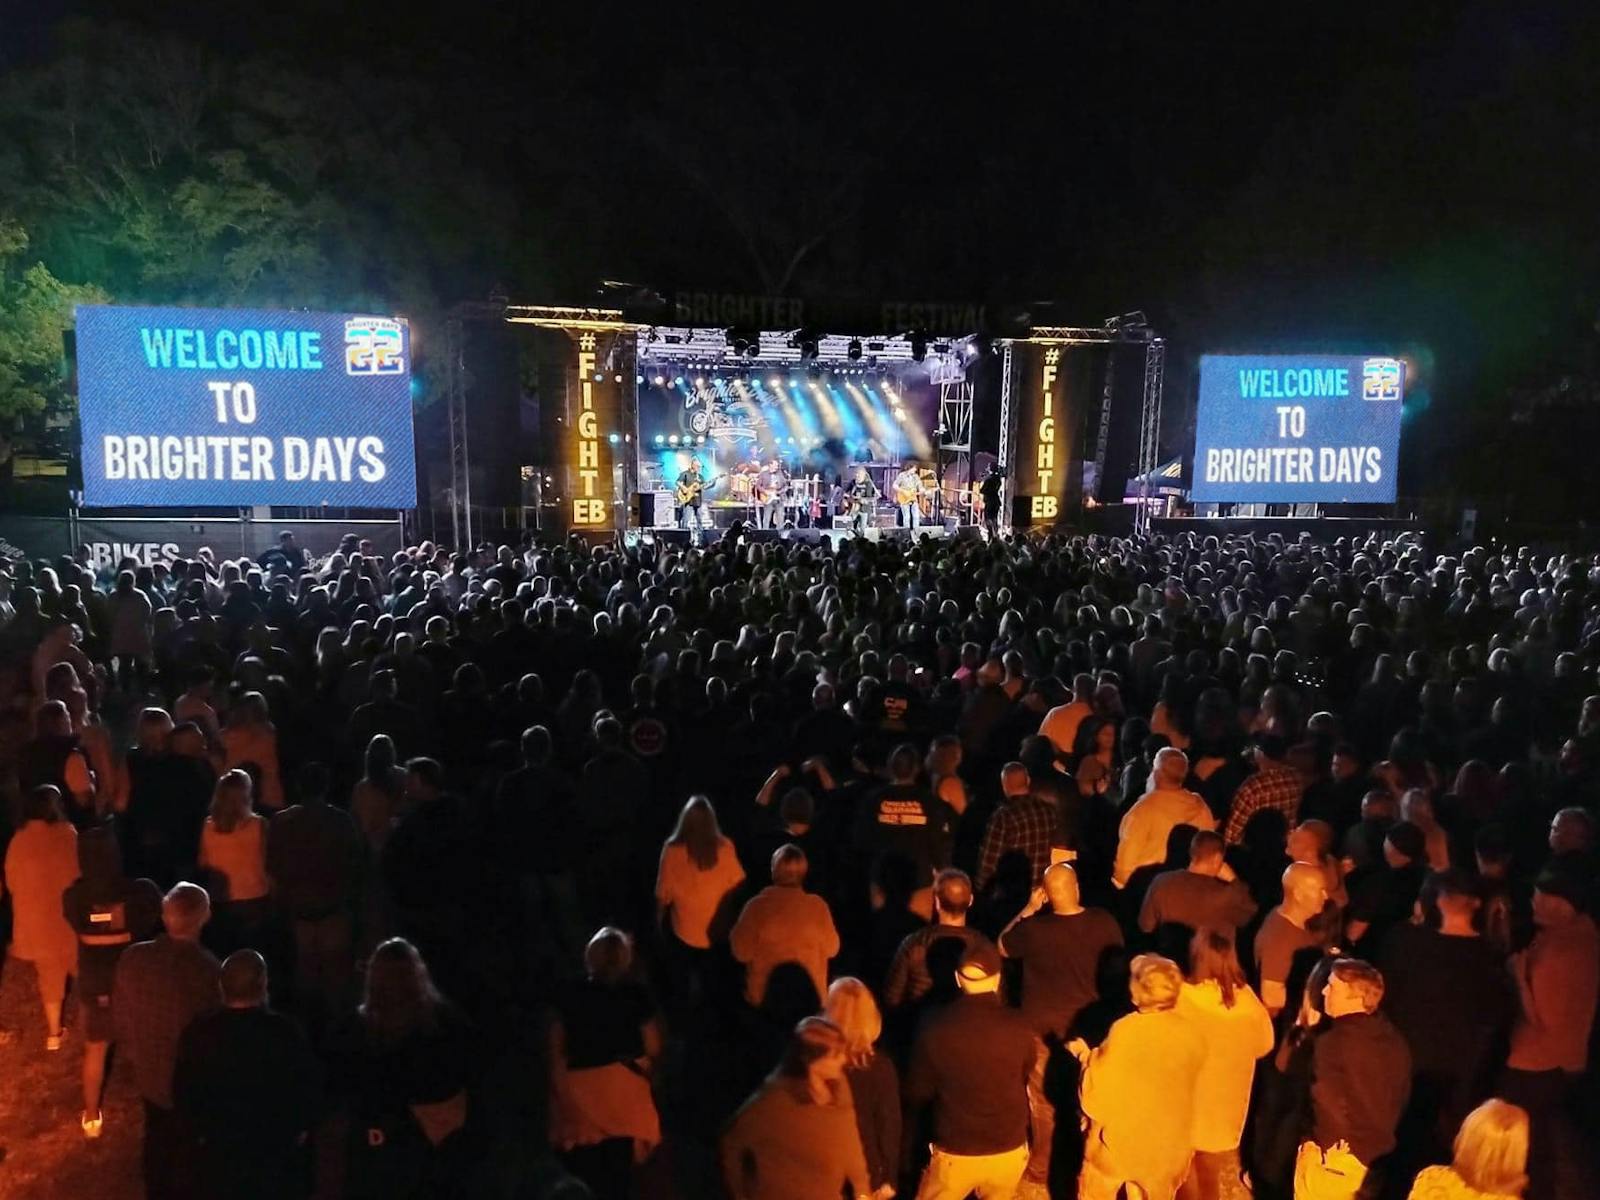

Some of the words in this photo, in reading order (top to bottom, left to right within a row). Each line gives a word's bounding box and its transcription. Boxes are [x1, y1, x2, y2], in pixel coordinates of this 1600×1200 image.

[674, 291, 804, 326] BRIGHTER
[139, 328, 323, 370] WELCOME
[345, 329, 404, 375] 22
[1239, 368, 1349, 398] WELCOME
[208, 381, 257, 423] TO
[1276, 406, 1306, 438] TO
[104, 435, 275, 481] BRIGHTER
[283, 436, 387, 483] DAYS
[1206, 447, 1314, 483] BRIGHTER
[1319, 446, 1382, 483] DAYS
[92, 542, 181, 571] BIKES
